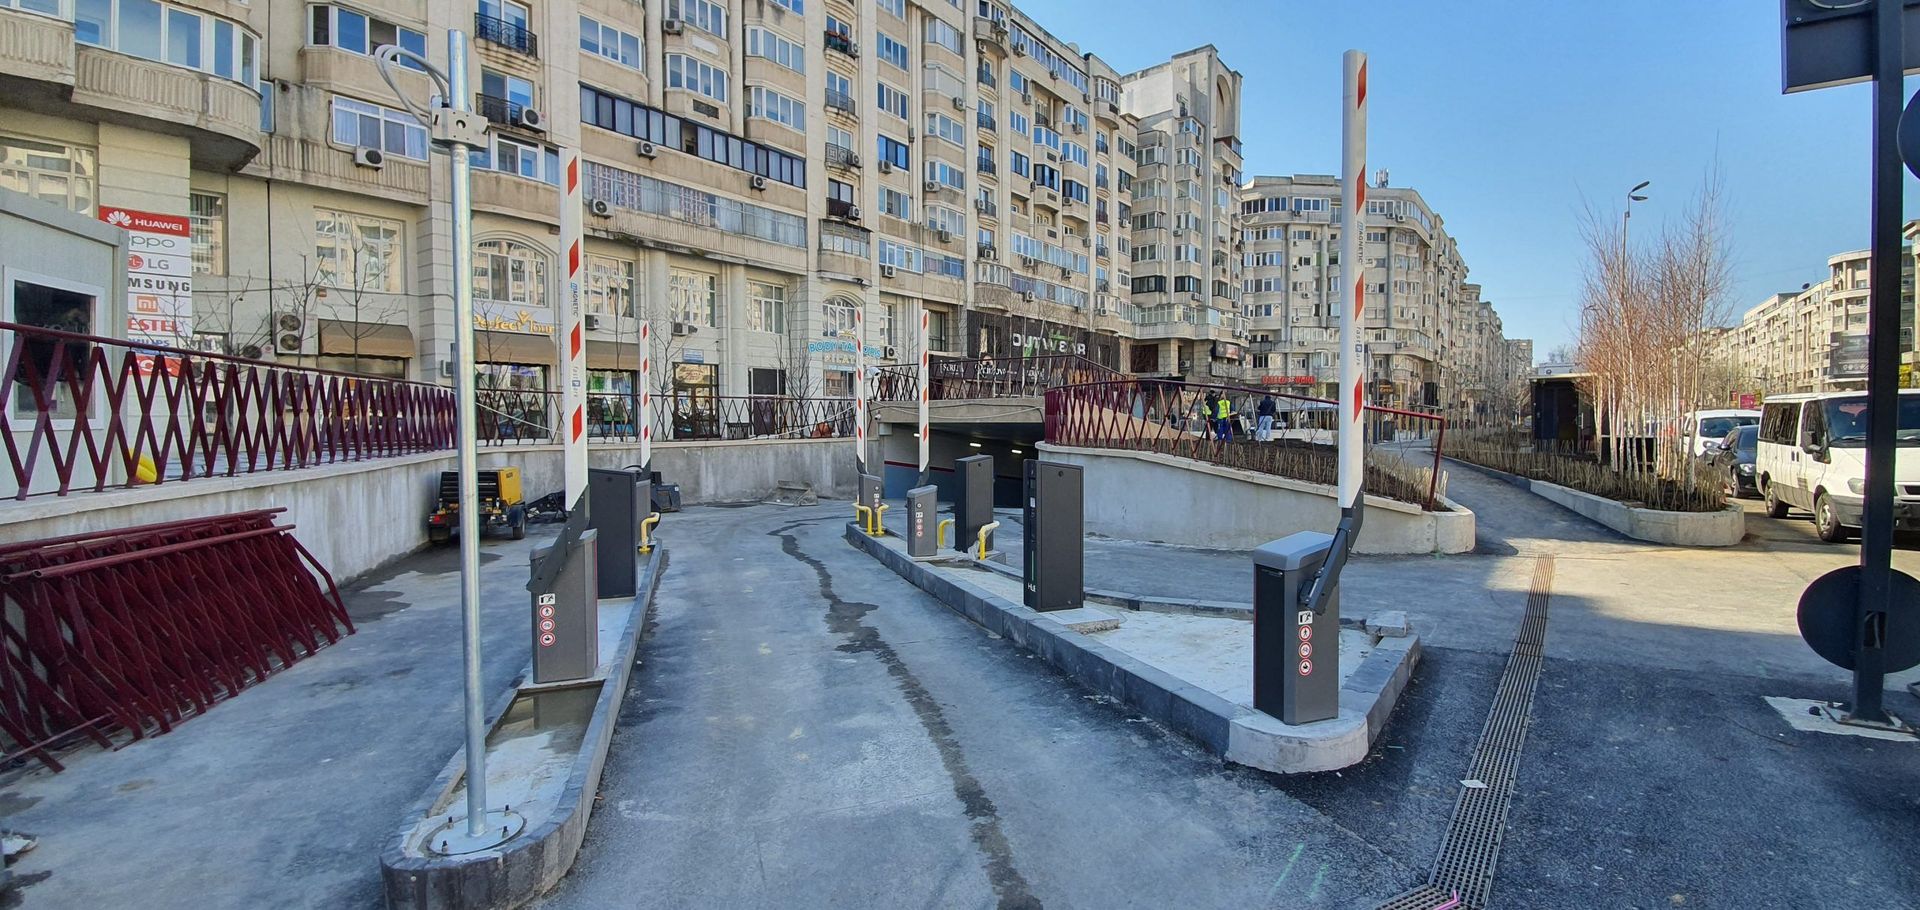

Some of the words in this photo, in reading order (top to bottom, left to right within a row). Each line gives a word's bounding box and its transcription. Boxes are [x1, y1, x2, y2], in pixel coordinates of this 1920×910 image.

[135, 218, 183, 231] HUAWEI
[128, 235, 176, 248] ppo
[148, 258, 170, 270] LG
[128, 318, 182, 332] ESTEL
[473, 313, 522, 331] Perfect
[528, 319, 555, 334] Tour
[808, 341, 837, 353] BODY
